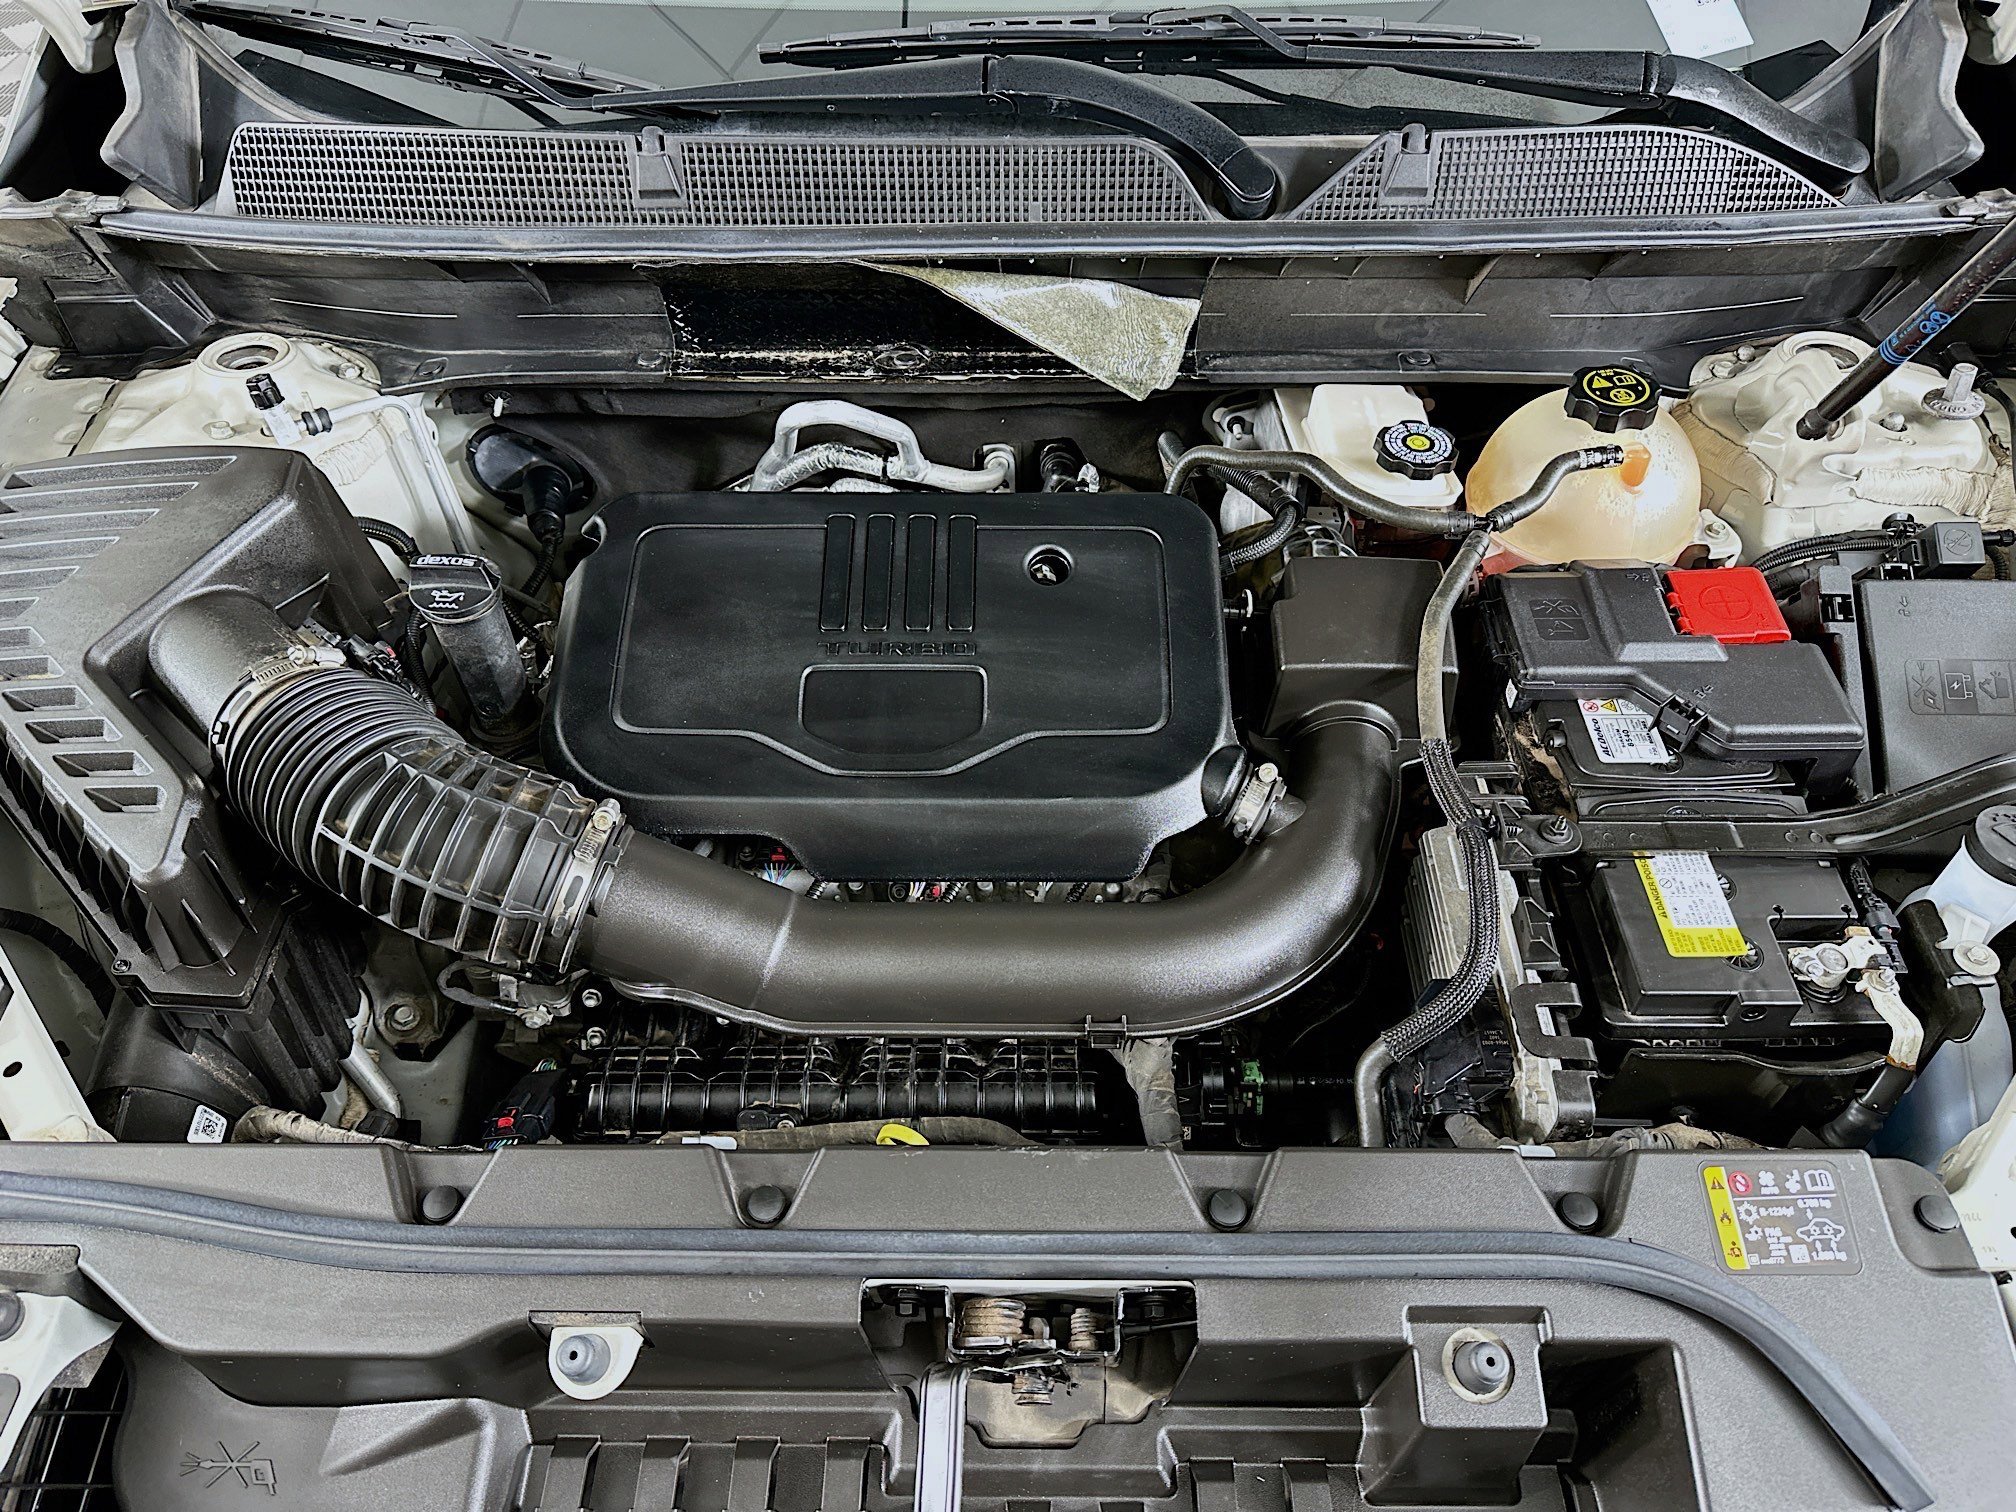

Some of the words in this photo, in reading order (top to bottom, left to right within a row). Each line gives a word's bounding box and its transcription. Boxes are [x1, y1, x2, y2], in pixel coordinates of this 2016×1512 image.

[416, 554, 478, 567] dexos
[817, 642, 977, 656] TURBO
[1591, 718, 1611, 757] ACDelco
[1622, 729, 1634, 747] 8540
[1639, 858, 1654, 881] POISO
[1648, 881, 1665, 911] DANGER
